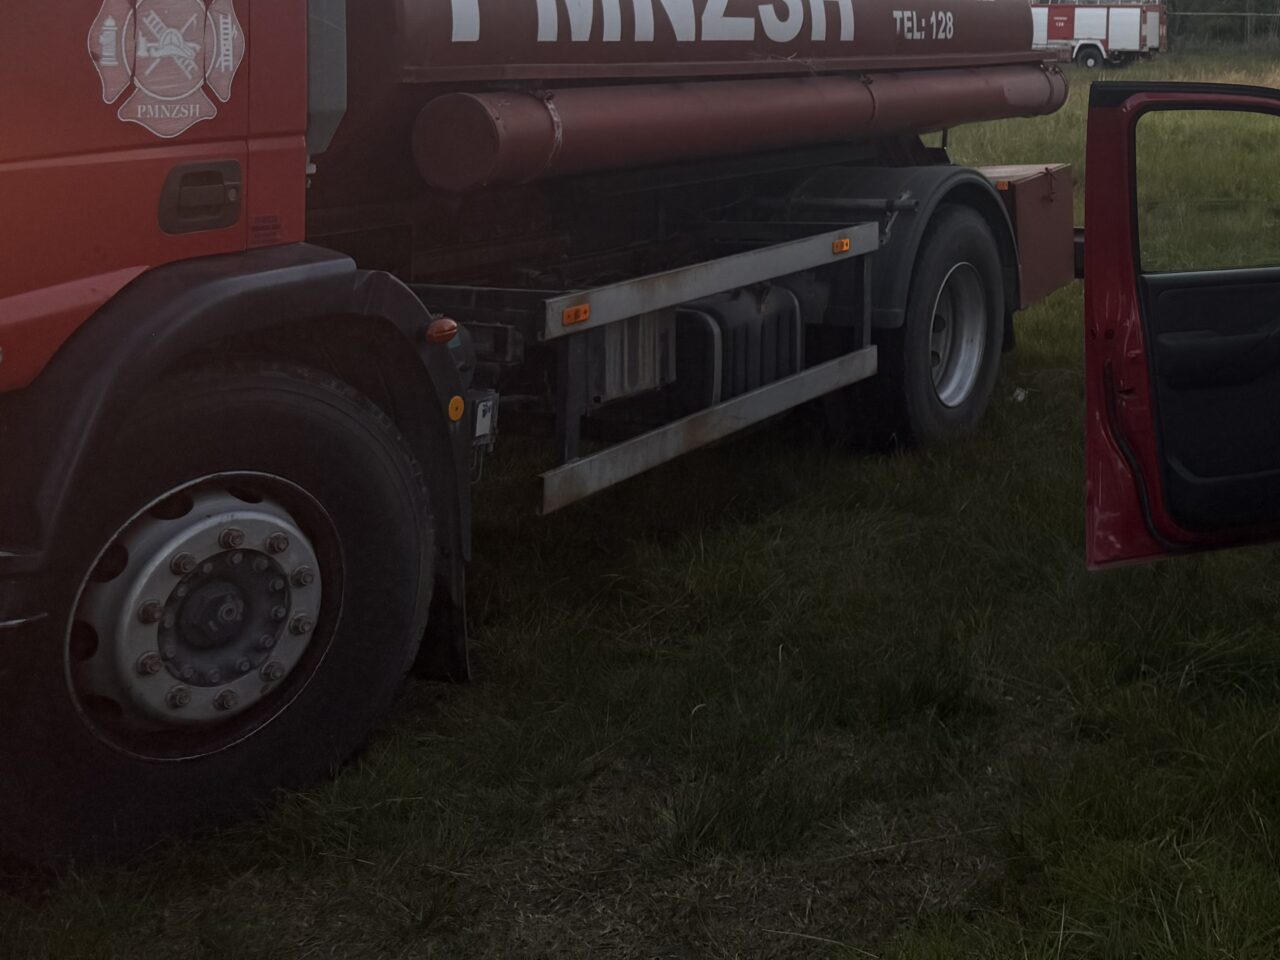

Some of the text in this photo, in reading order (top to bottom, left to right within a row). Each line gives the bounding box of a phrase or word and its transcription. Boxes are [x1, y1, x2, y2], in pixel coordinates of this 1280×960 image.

[893, 10, 955, 40] TEL: 128
[137, 103, 201, 119] PMNZSH
